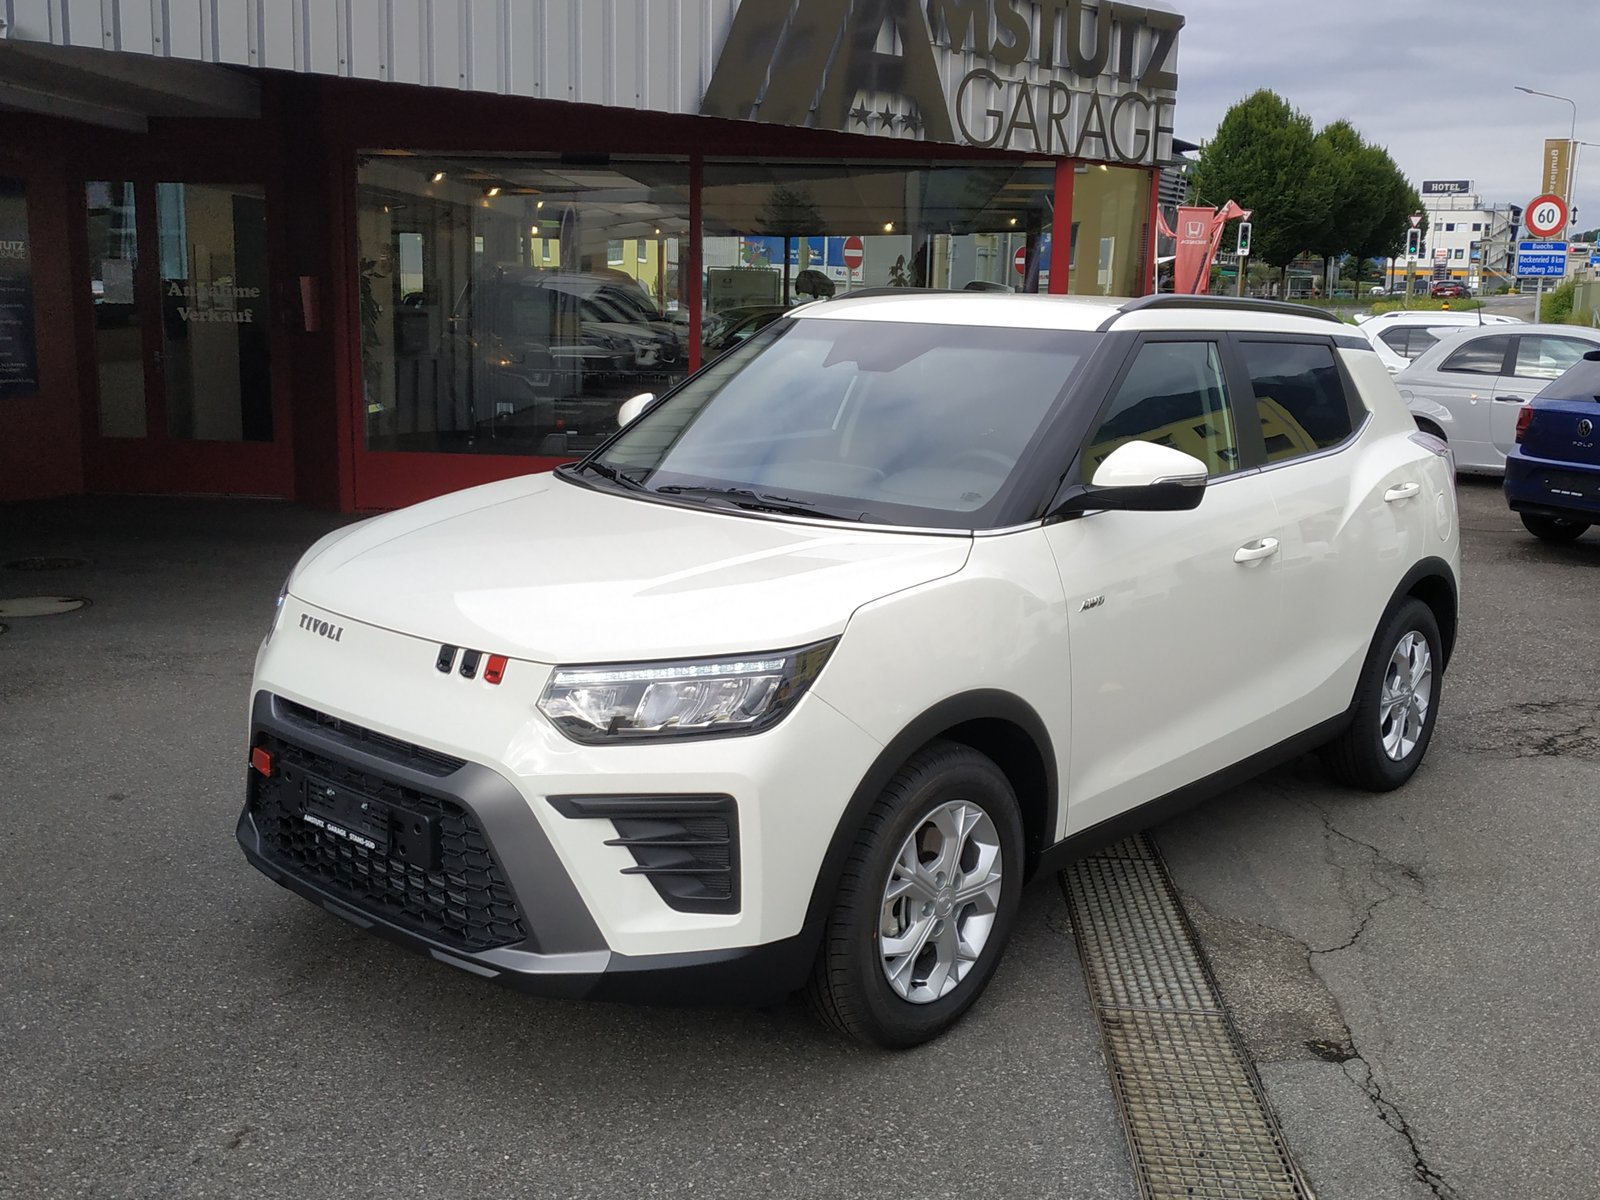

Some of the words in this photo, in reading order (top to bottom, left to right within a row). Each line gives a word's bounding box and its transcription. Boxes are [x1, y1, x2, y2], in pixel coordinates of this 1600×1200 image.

[956, 67, 1176, 165] GARAGE
[1537, 208, 1555, 224] 60
[1519, 255, 1550, 264] Beckenried
[1555, 255, 1564, 264] km
[1518, 264, 1546, 275] Engelberg
[1546, 265, 1555, 273] 20
[1554, 265, 1563, 273] km
[176, 306, 254, 323] Verkauf
[299, 613, 344, 642] TIVOLI
[327, 823, 347, 838] GARAGE
